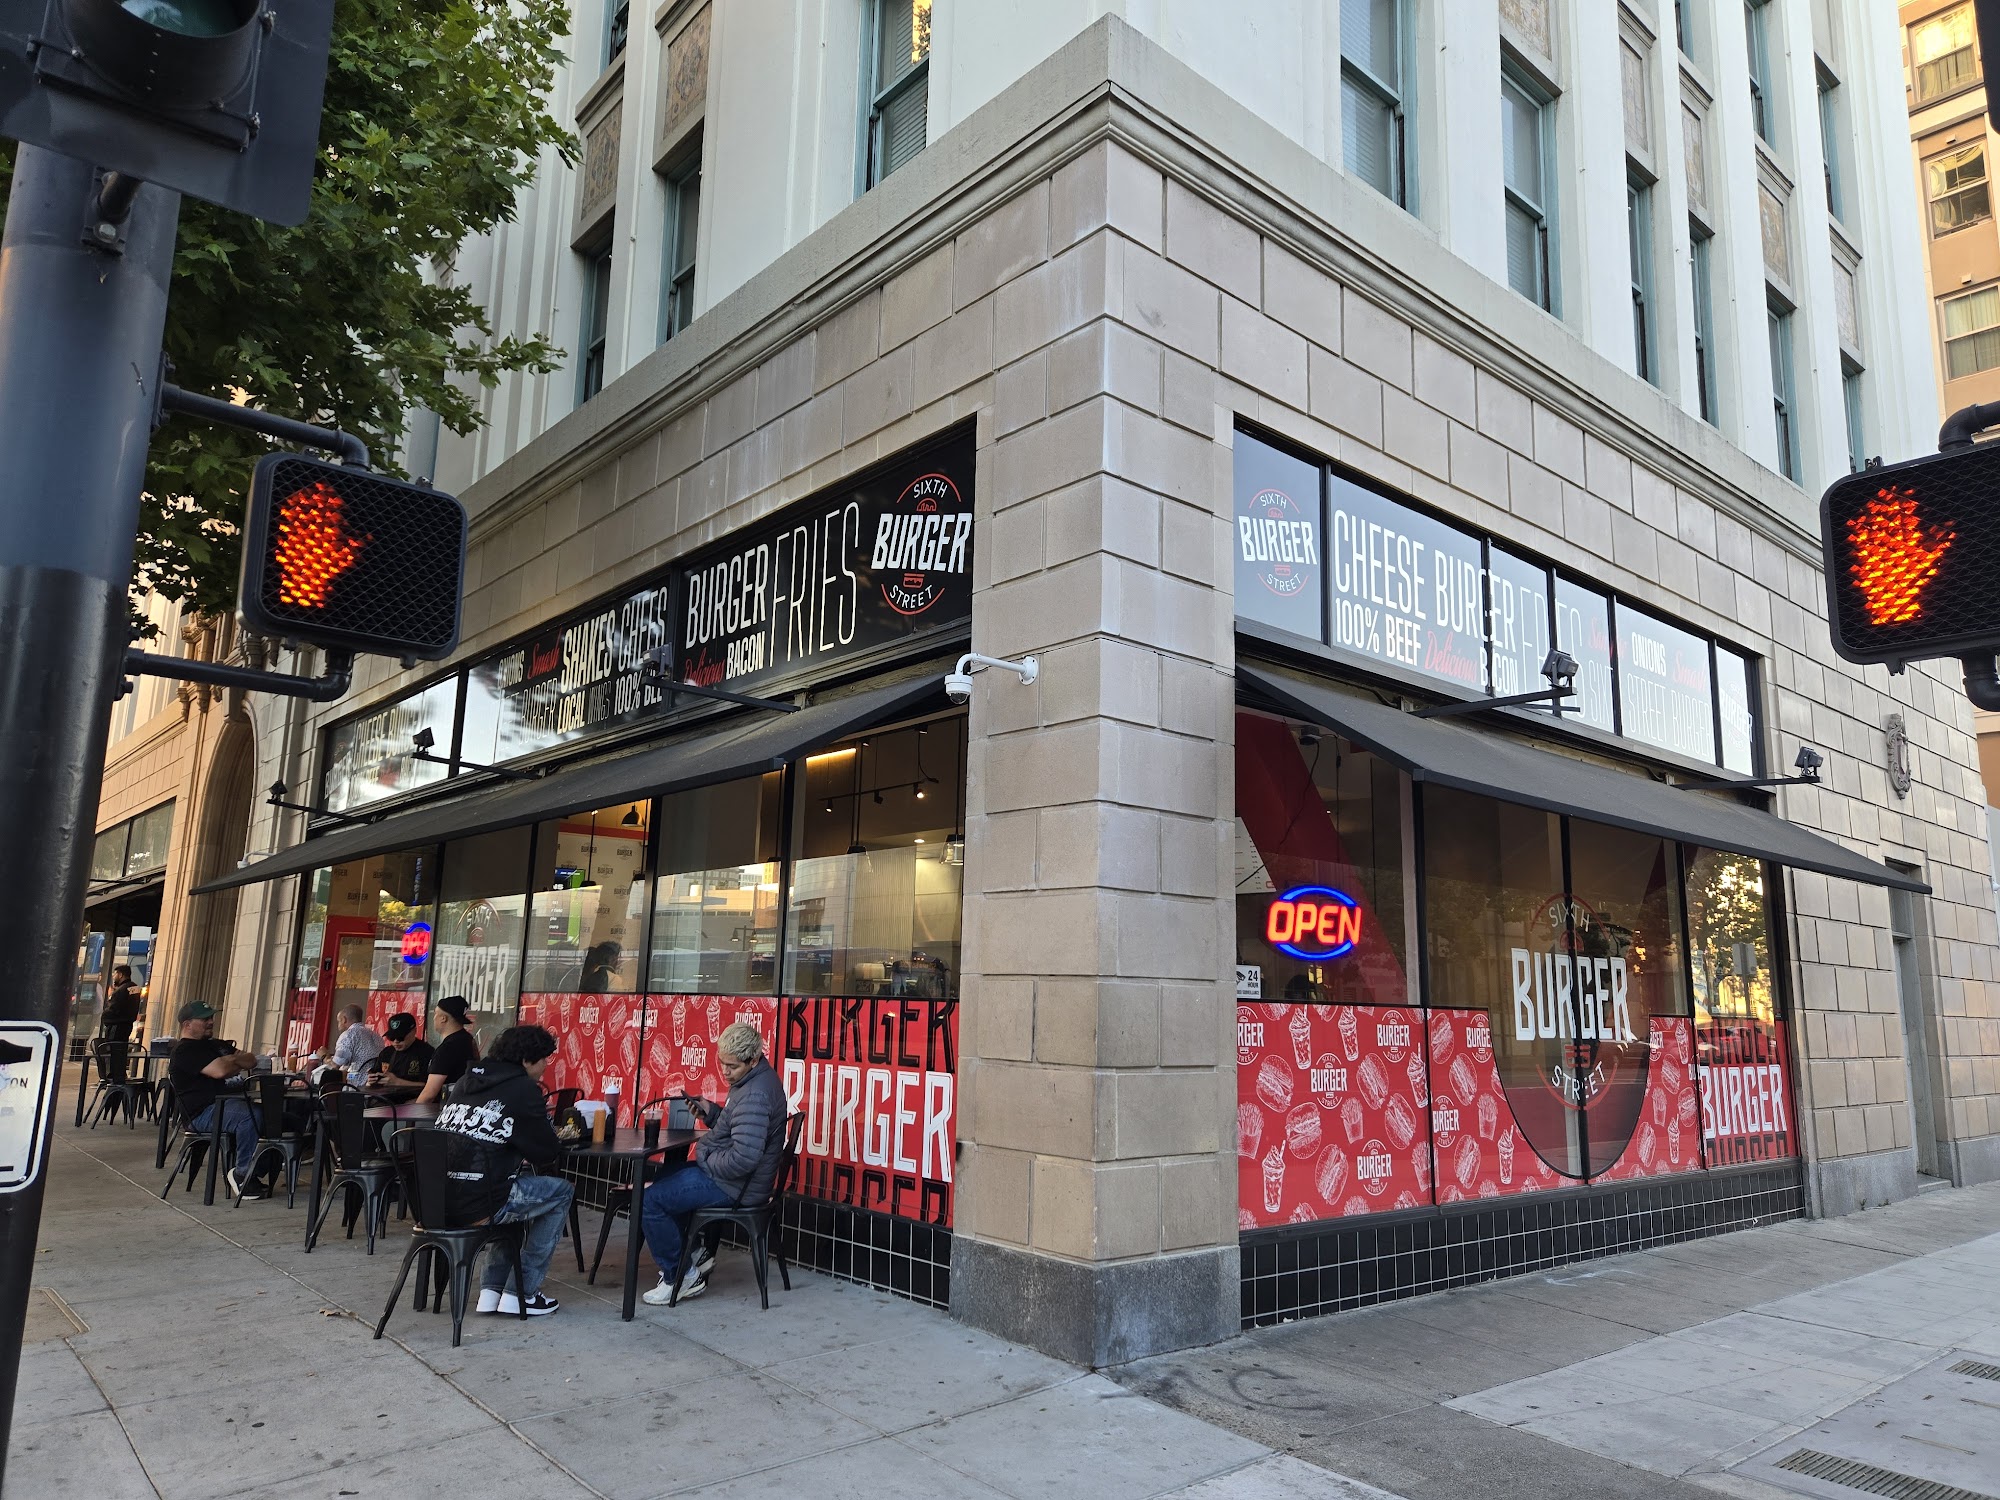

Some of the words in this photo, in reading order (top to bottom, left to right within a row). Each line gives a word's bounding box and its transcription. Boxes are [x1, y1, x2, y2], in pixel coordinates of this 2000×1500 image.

[913, 479, 948, 498] SIXTH
[1260, 492, 1287, 509] SIXTH
[871, 512, 973, 574] BURGER
[1238, 515, 1318, 565] BURGER
[685, 543, 769, 650] BURGER
[769, 501, 860, 668] FRIES
[889, 584, 933, 609] STREET
[1266, 572, 1302, 592] STREET
[1334, 509, 1427, 621] CHEESE
[1435, 549, 1516, 653] BURGER
[561, 609, 616, 694] SHAKES
[683, 647, 726, 688] Delicious
[726, 630, 765, 681] BACON
[1335, 597, 1380, 654] 100%
[1385, 613, 1422, 666] BEEF
[1424, 629, 1478, 684] Delicious
[1479, 646, 1519, 696] BCON
[1520, 585, 1586, 719] FRES
[1631, 631, 1666, 677] ONIONS
[557, 691, 585, 735] LOCAL
[614, 670, 642, 716] 100%
[1627, 672, 1666, 743] STREET
[1671, 689, 1714, 758] BURGER
[466, 905, 492, 929] SIXTH
[1267, 901, 1362, 945] OPEN
[1549, 902, 1590, 932] SIXTH
[438, 943, 510, 1014] BURGER
[1247, 969, 1258, 981] 24
[1511, 947, 1634, 1042] BURGER
[632, 1009, 658, 1027] BUGER
[1237, 1022, 1265, 1047] RGER
[1377, 1023, 1411, 1047] BURGER
[1466, 1026, 1492, 1048] BURGE
[681, 1046, 707, 1068] BURGER
[1310, 1068, 1348, 1092] BURGER
[1700, 1064, 1788, 1139] BURGER
[782, 1058, 954, 1183] BURGER
[1356, 1153, 1392, 1180] BURGER
